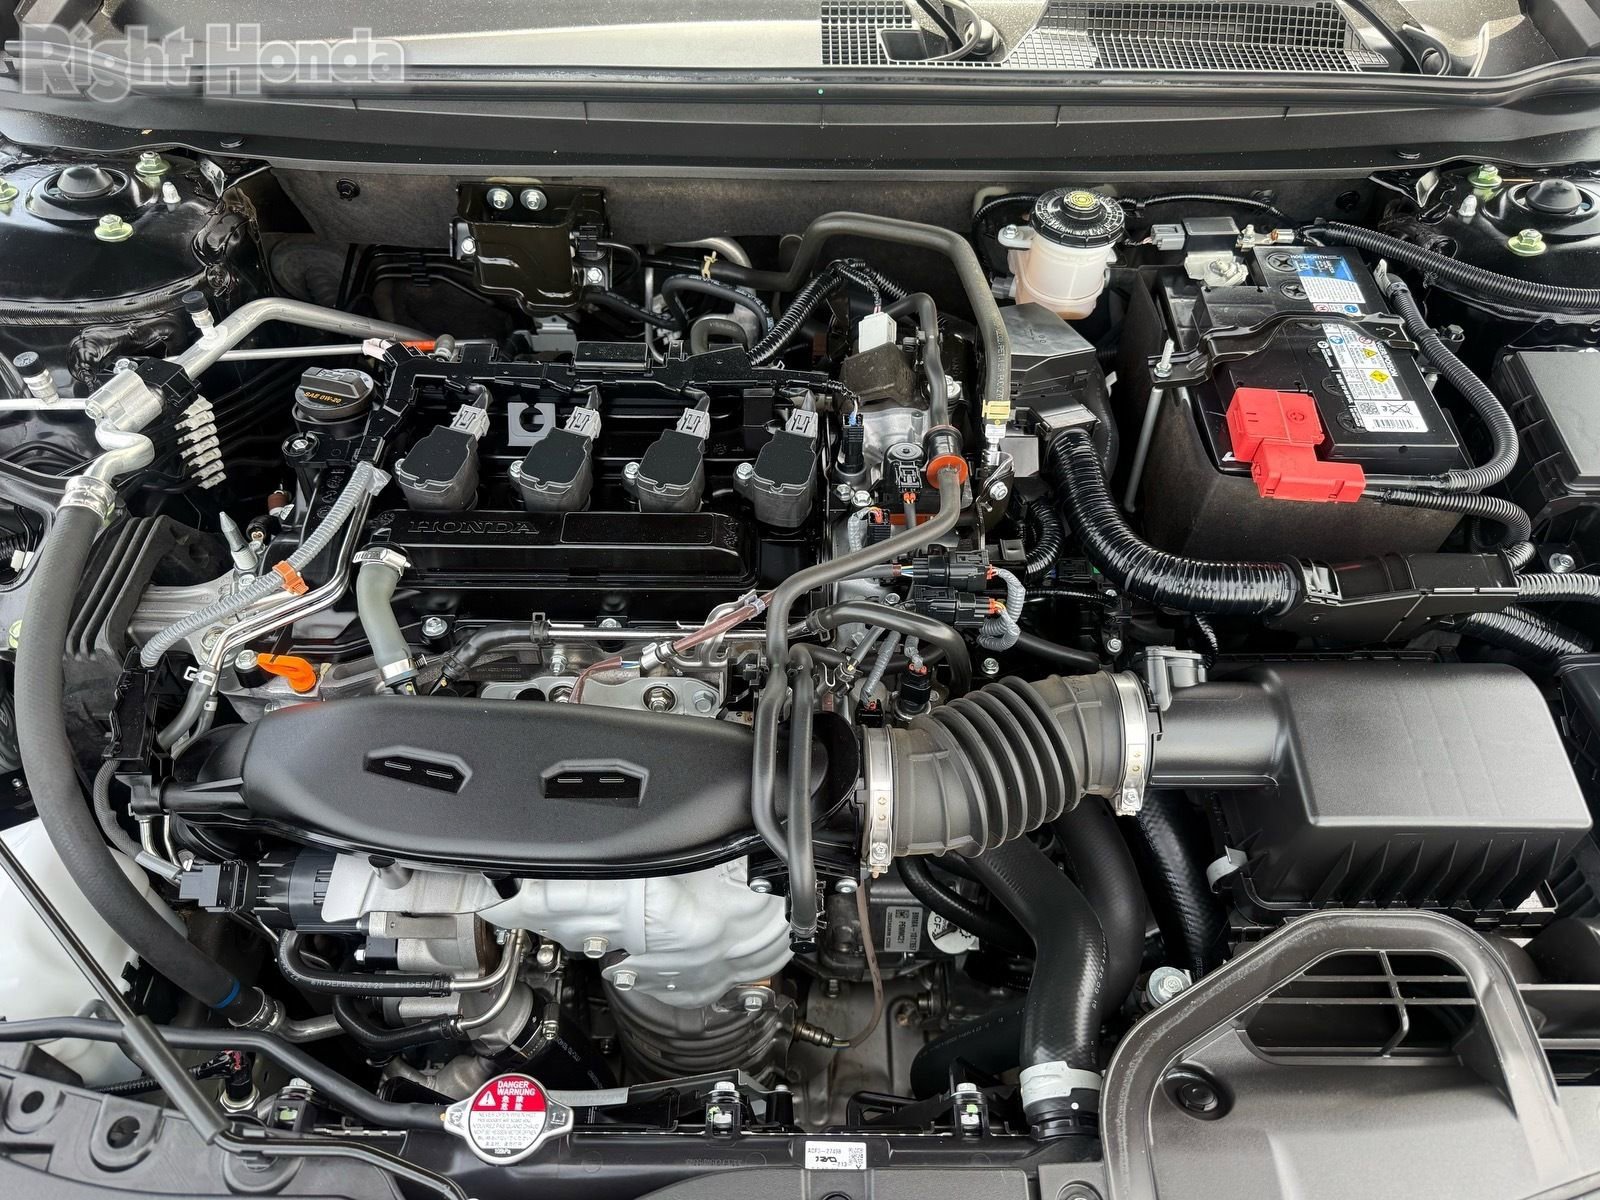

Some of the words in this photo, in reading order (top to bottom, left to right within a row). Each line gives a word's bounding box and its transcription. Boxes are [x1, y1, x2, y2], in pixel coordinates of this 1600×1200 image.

[303, 391, 320, 399] SAE
[320, 393, 342, 404] 0W-20
[407, 520, 540, 535] HONDA
[497, 1080, 529, 1088] DANGER
[497, 1088, 536, 1096] WARNUNG
